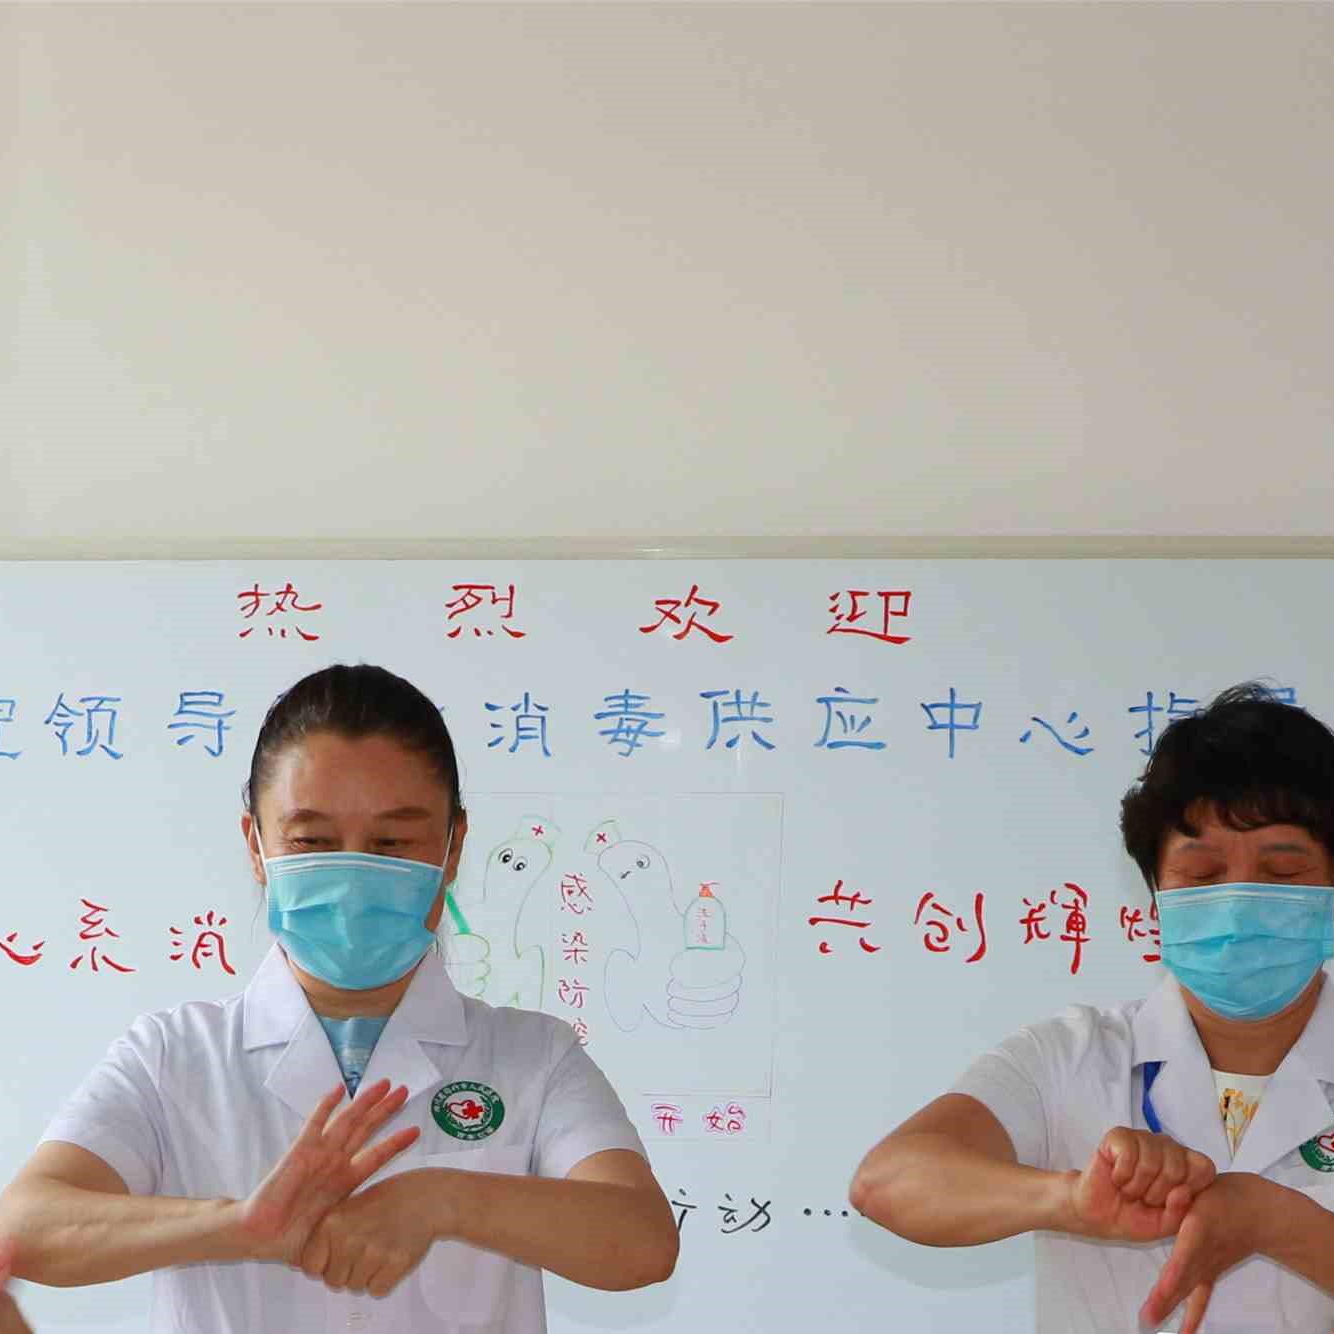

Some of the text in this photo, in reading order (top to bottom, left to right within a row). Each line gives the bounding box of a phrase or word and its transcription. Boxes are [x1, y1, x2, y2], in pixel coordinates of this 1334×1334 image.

[237, 582, 915, 646] 热烈欢迎
[483, 687, 1298, 760] 消毒供应中心指
